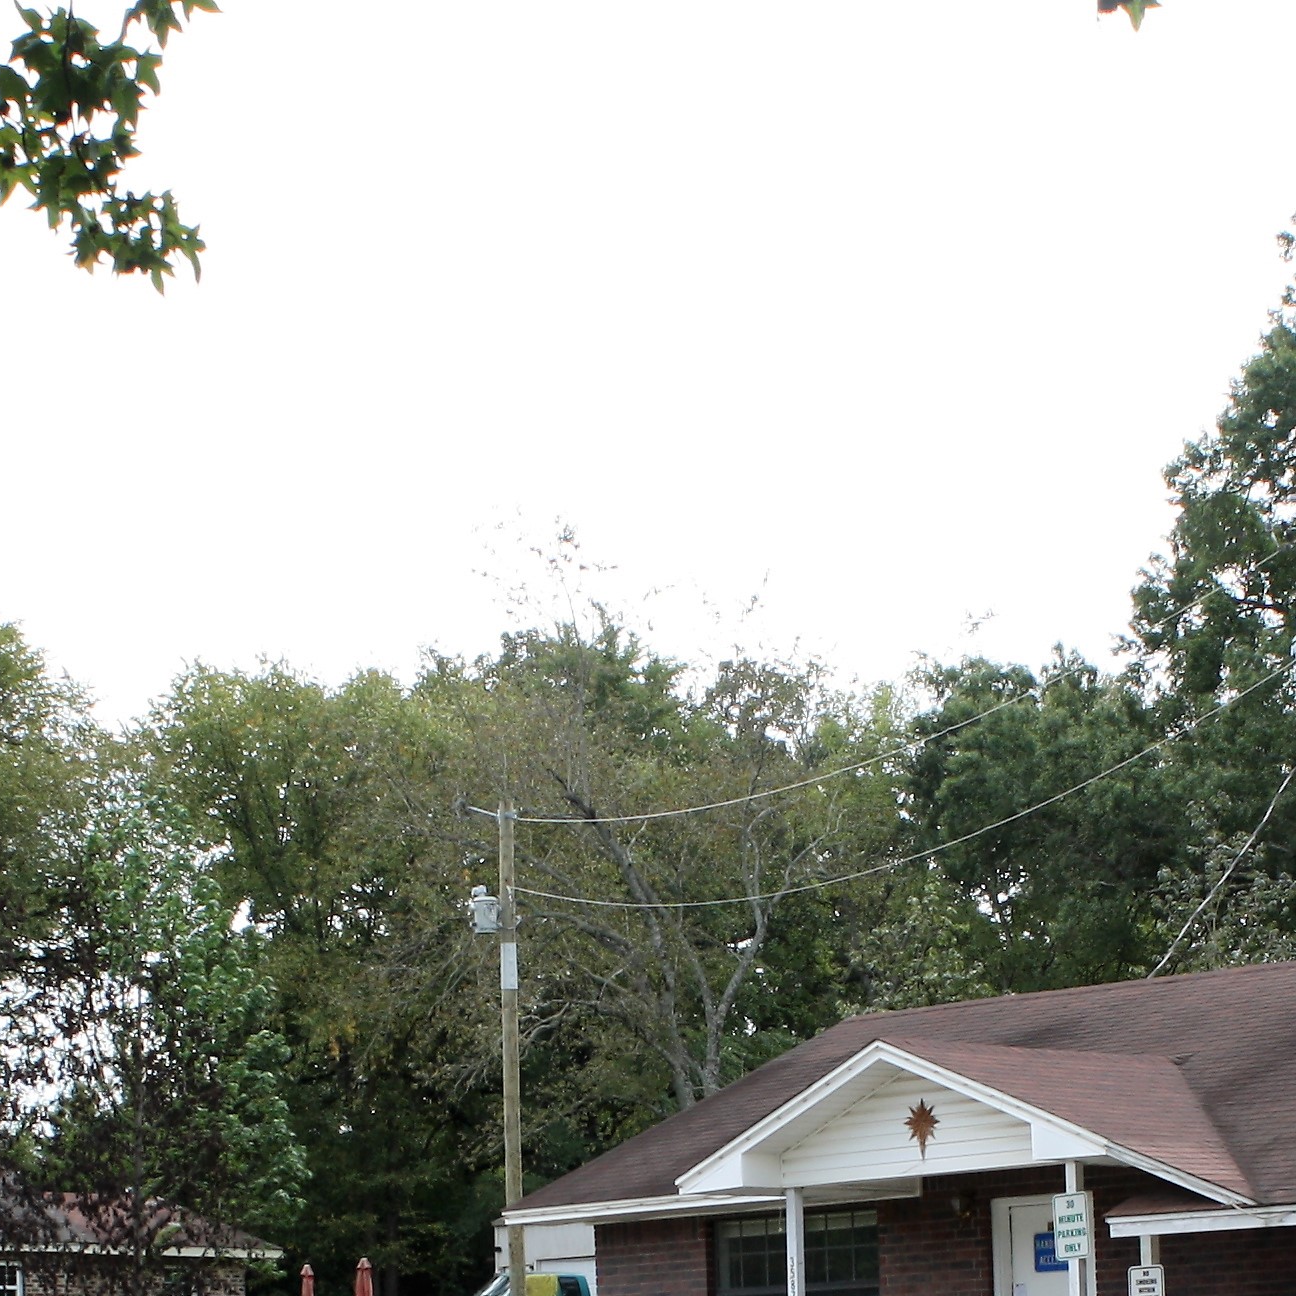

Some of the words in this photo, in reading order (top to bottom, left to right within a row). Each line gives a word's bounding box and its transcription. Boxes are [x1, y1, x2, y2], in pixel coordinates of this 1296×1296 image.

[1066, 1200, 1075, 1209] 30
[1058, 1213, 1084, 1223] MINUTE
[1057, 1227, 1086, 1238] PARKING
[1064, 1243, 1081, 1252] ONLY
